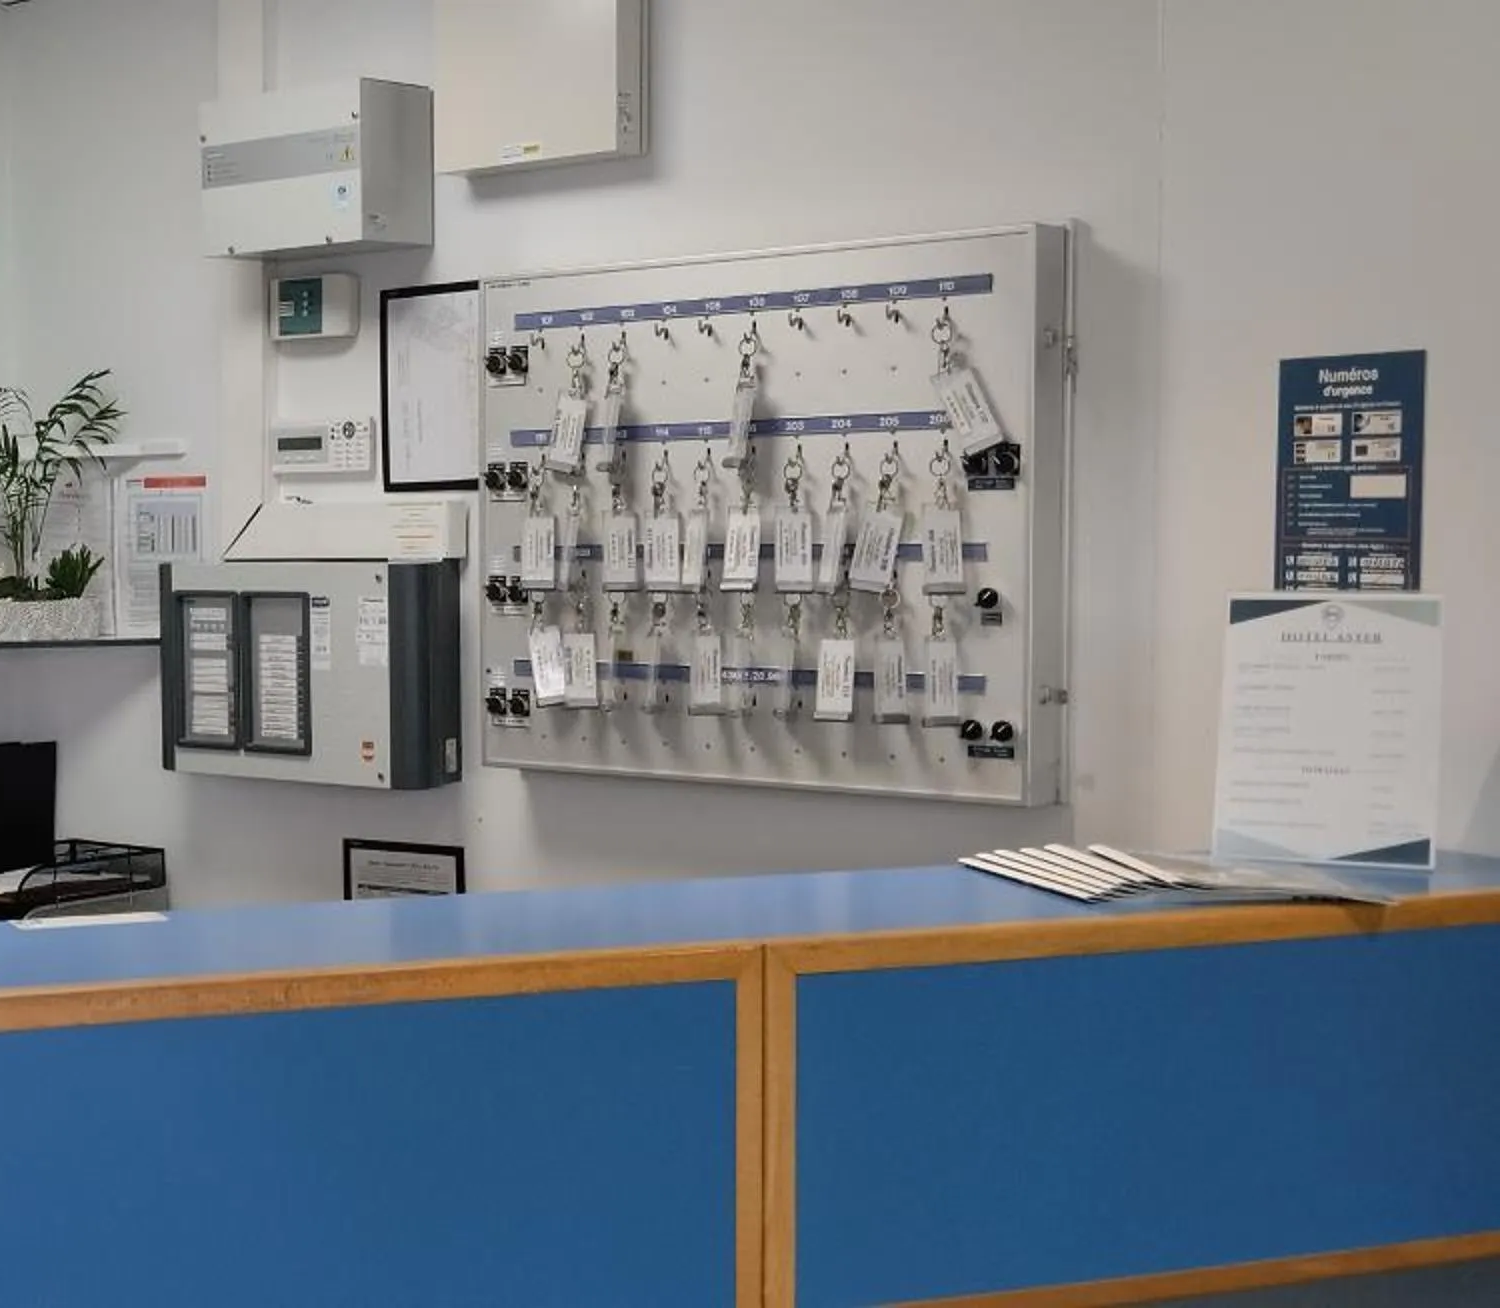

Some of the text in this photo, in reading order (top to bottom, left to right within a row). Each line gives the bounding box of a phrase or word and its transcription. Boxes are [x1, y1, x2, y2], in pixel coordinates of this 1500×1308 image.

[1318, 367, 1379, 383] Numéros
[1323, 385, 1373, 398] d'urgence
[831, 418, 852, 429] 204
